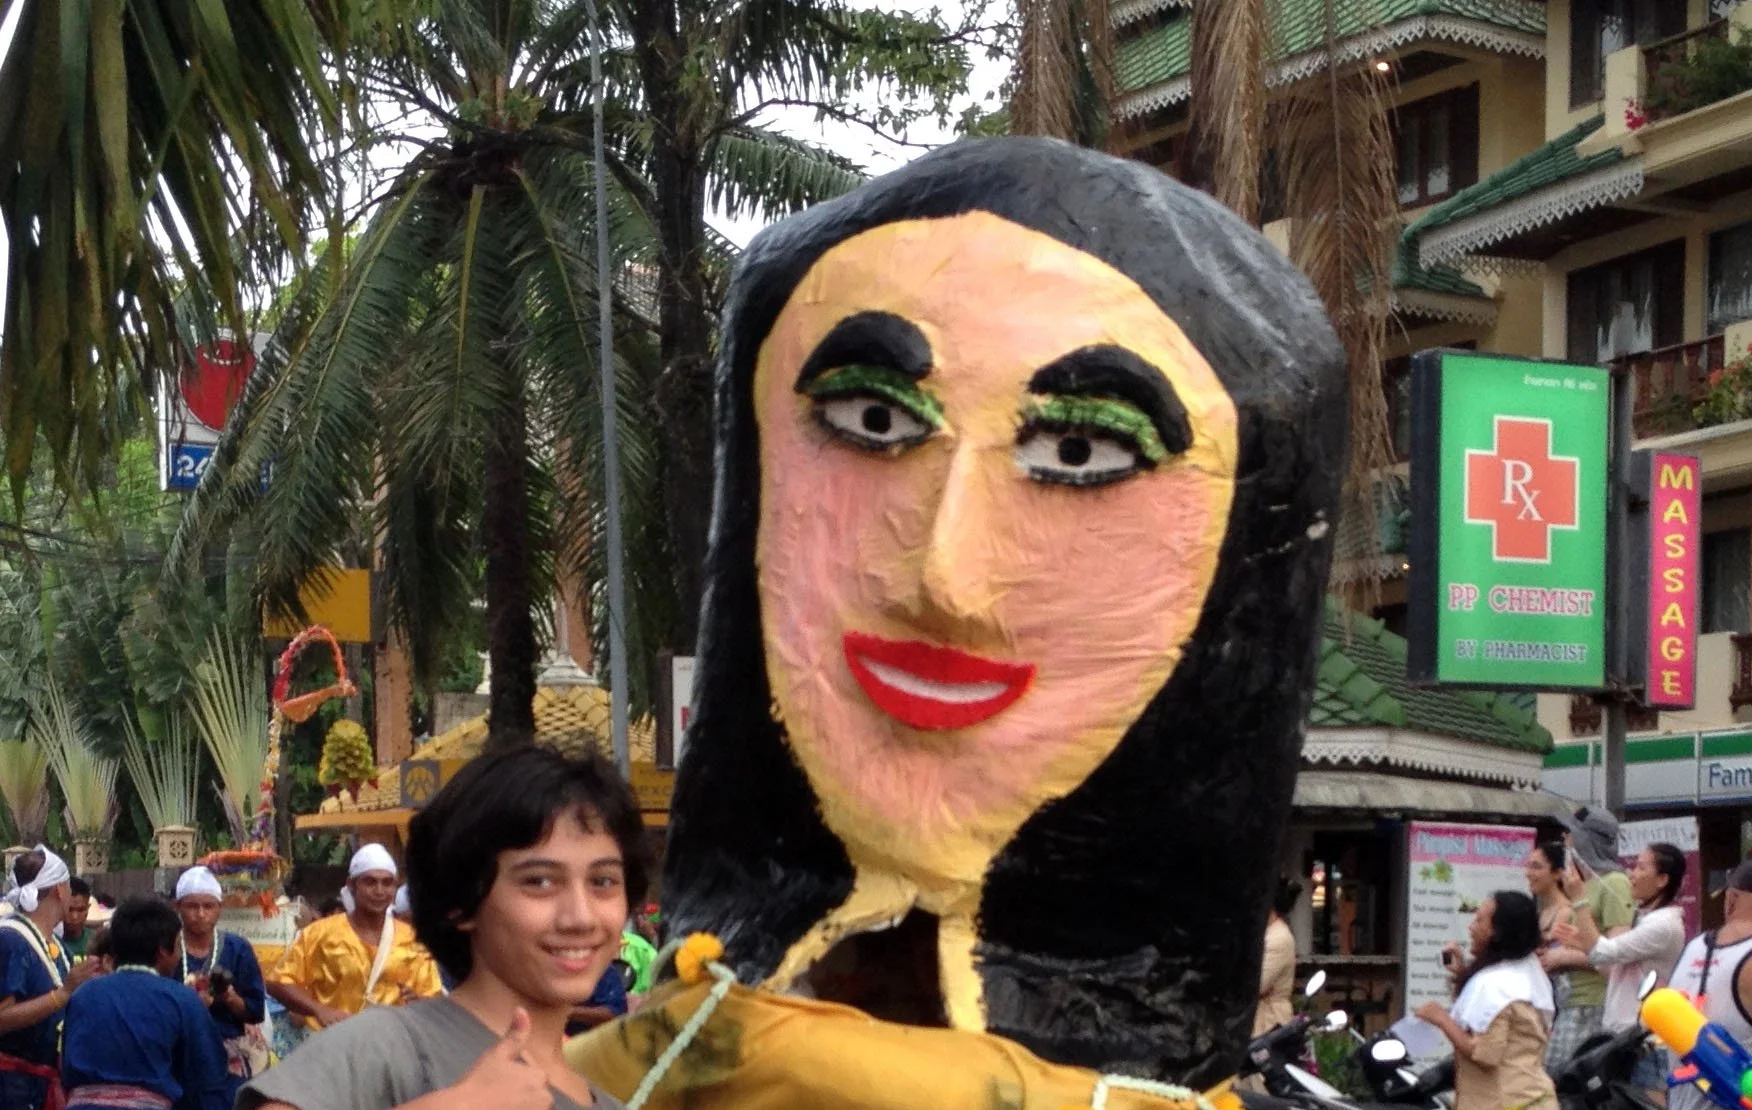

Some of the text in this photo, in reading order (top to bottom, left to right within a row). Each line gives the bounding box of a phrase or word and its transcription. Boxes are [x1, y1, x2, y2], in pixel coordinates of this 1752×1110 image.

[1659, 464, 1693, 697] MASSAGE
[1449, 583, 1595, 616] PP CHEMIST
[1456, 639, 1586, 663] BY PHARMACIST
